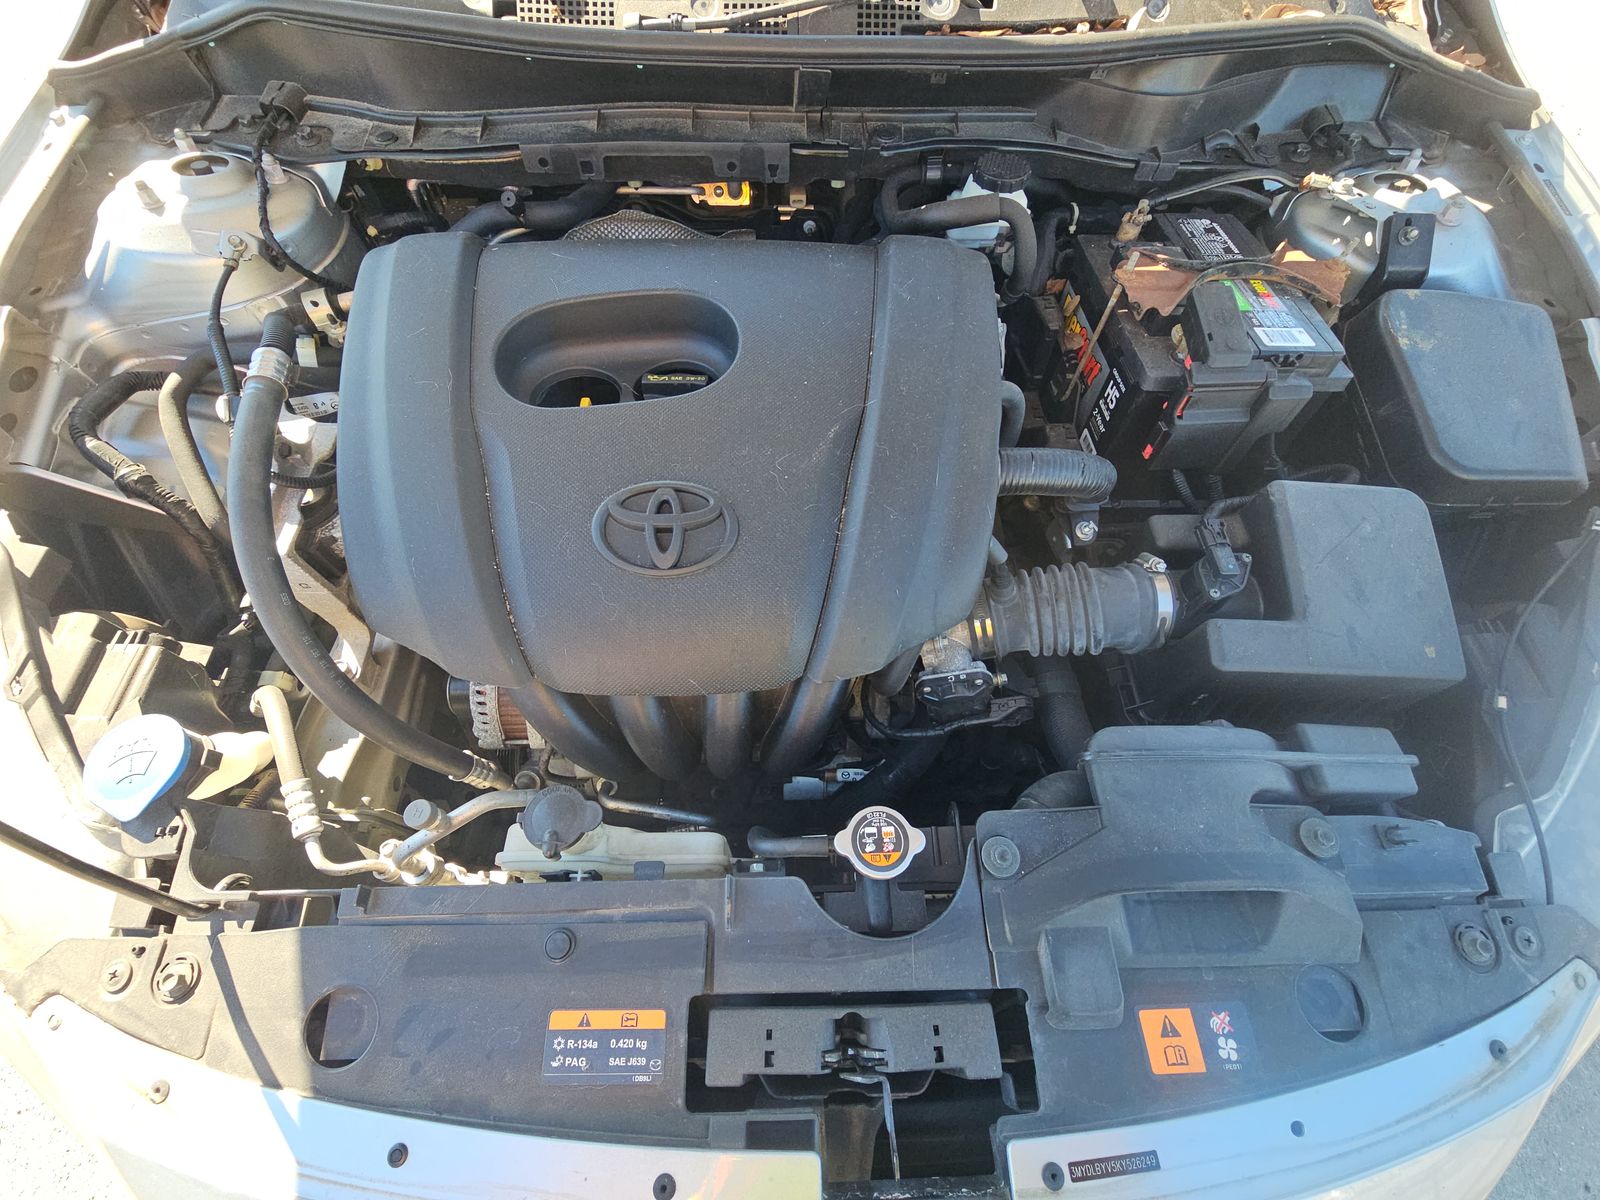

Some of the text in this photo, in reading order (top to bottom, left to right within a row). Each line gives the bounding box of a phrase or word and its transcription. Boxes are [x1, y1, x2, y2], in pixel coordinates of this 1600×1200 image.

[1104, 380, 1120, 410] H5
[1092, 407, 1106, 433] 2-Year
[567, 1039, 647, 1050] R-134a 0.420 kg
[565, 1058, 646, 1067] PAG SAE J639
[1071, 1155, 1156, 1178] 3MYDLBYV5KY526249
